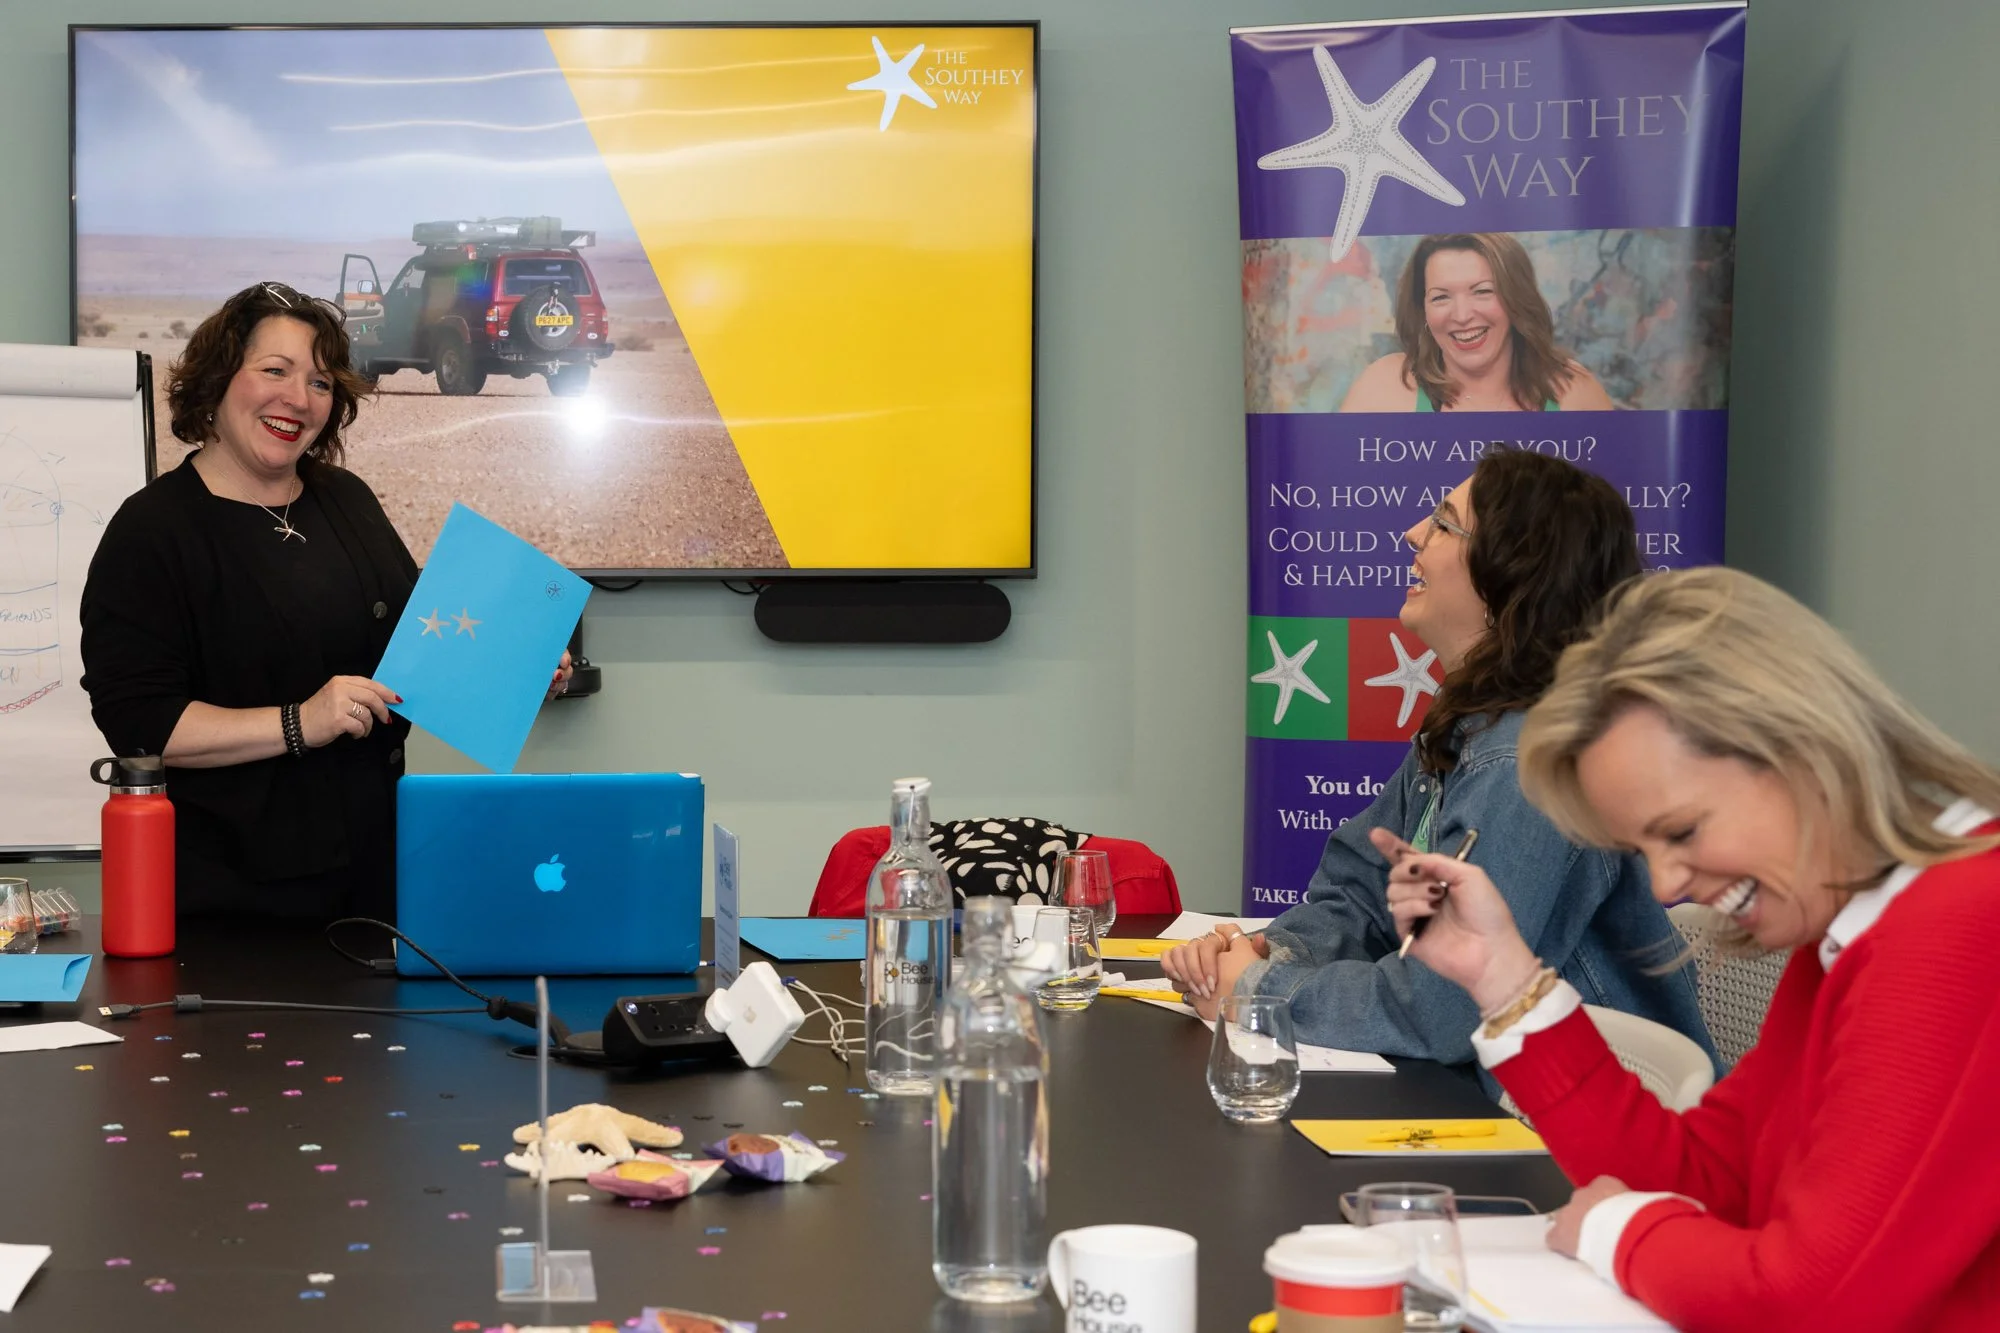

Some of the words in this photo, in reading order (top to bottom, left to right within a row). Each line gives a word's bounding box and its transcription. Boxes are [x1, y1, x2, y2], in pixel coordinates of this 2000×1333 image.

[933, 50, 968, 64] THE
[925, 68, 1024, 86] SOUTHEY
[1450, 58, 1532, 91] THE
[944, 89, 982, 104] WAY
[1427, 93, 1711, 145] SOUTHEY
[1462, 152, 1596, 199] WAY
[1359, 437, 1437, 463] HOW
[1515, 436, 1597, 462] YOU?
[1270, 483, 1321, 510] NO,
[1331, 486, 1408, 508] HOW
[1268, 527, 1378, 553] COULD
[1284, 563, 1305, 586] &
[1305, 775, 1351, 795] You
[1278, 809, 1333, 830] With
[1252, 886, 1300, 904] TAKE
[901, 962, 929, 975] Bee
[1073, 1278, 1127, 1316] Bee
